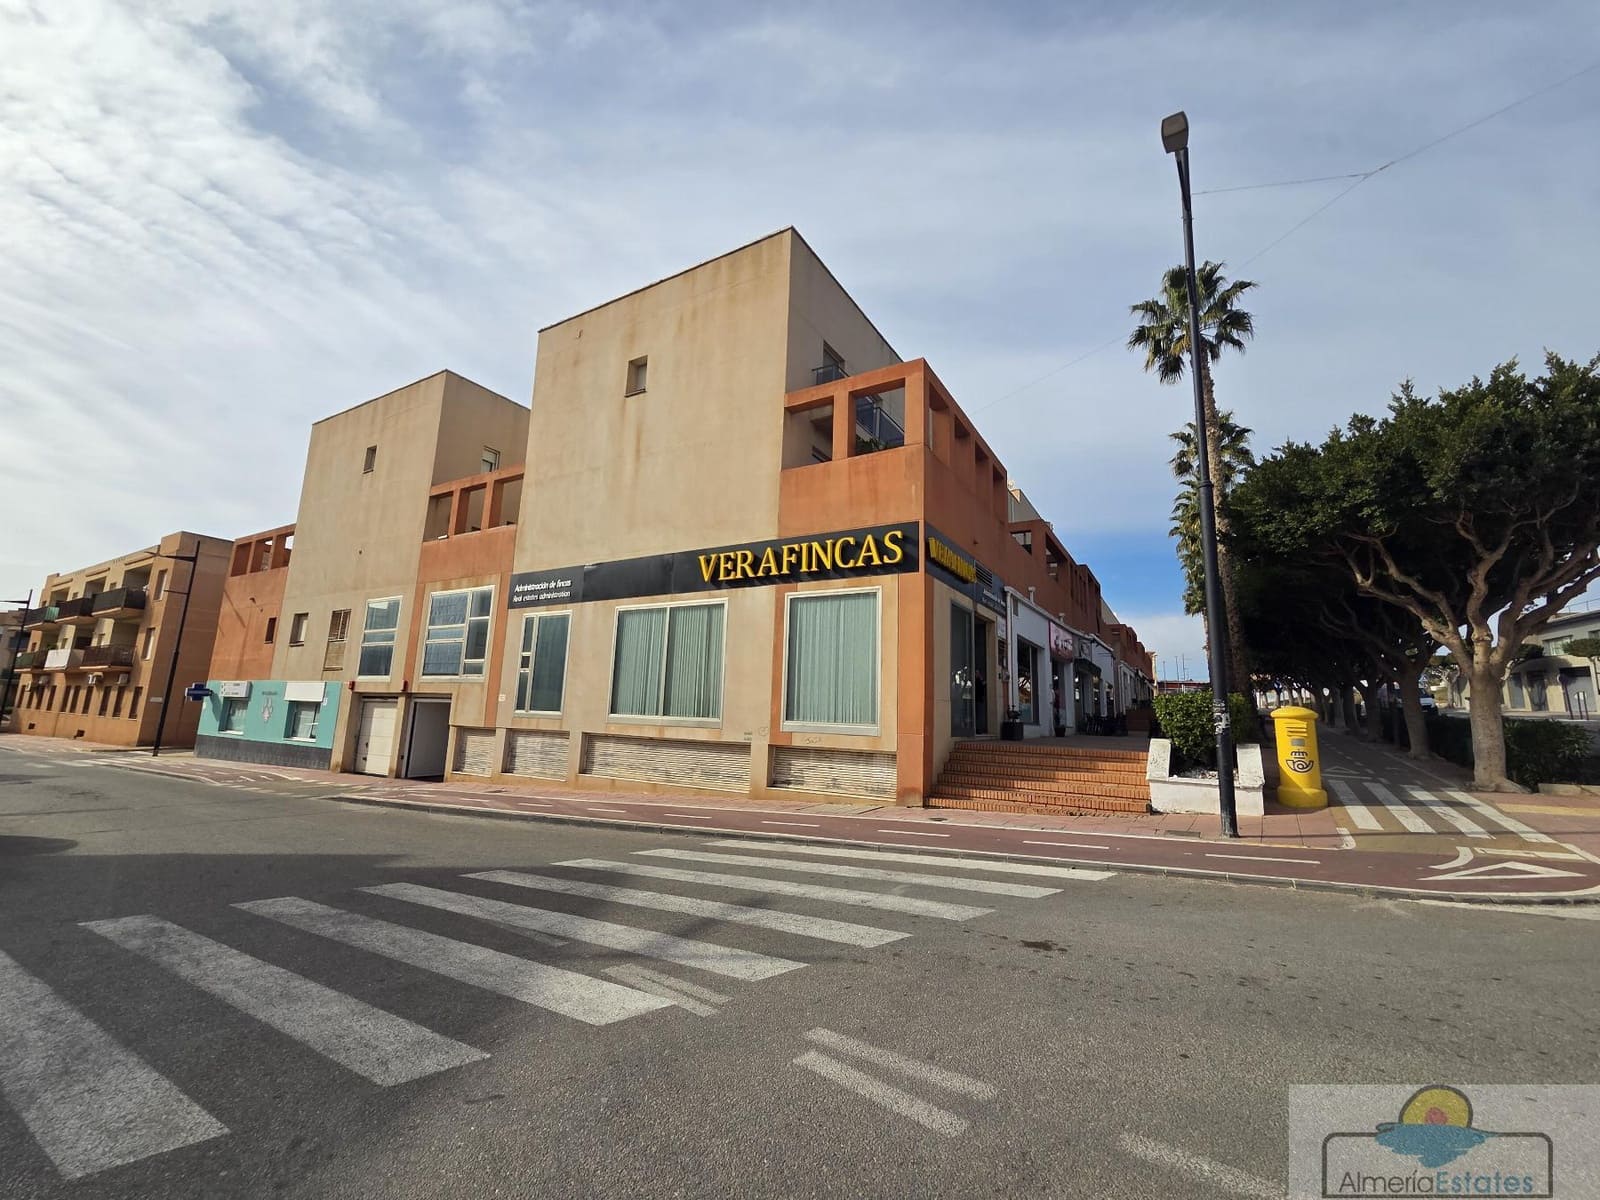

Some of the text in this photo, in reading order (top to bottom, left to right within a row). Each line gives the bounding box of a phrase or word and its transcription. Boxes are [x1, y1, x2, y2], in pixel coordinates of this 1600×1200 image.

[698, 530, 903, 582] VERAFINCAS
[549, 580, 556, 588] de
[557, 579, 571, 587] fincas
